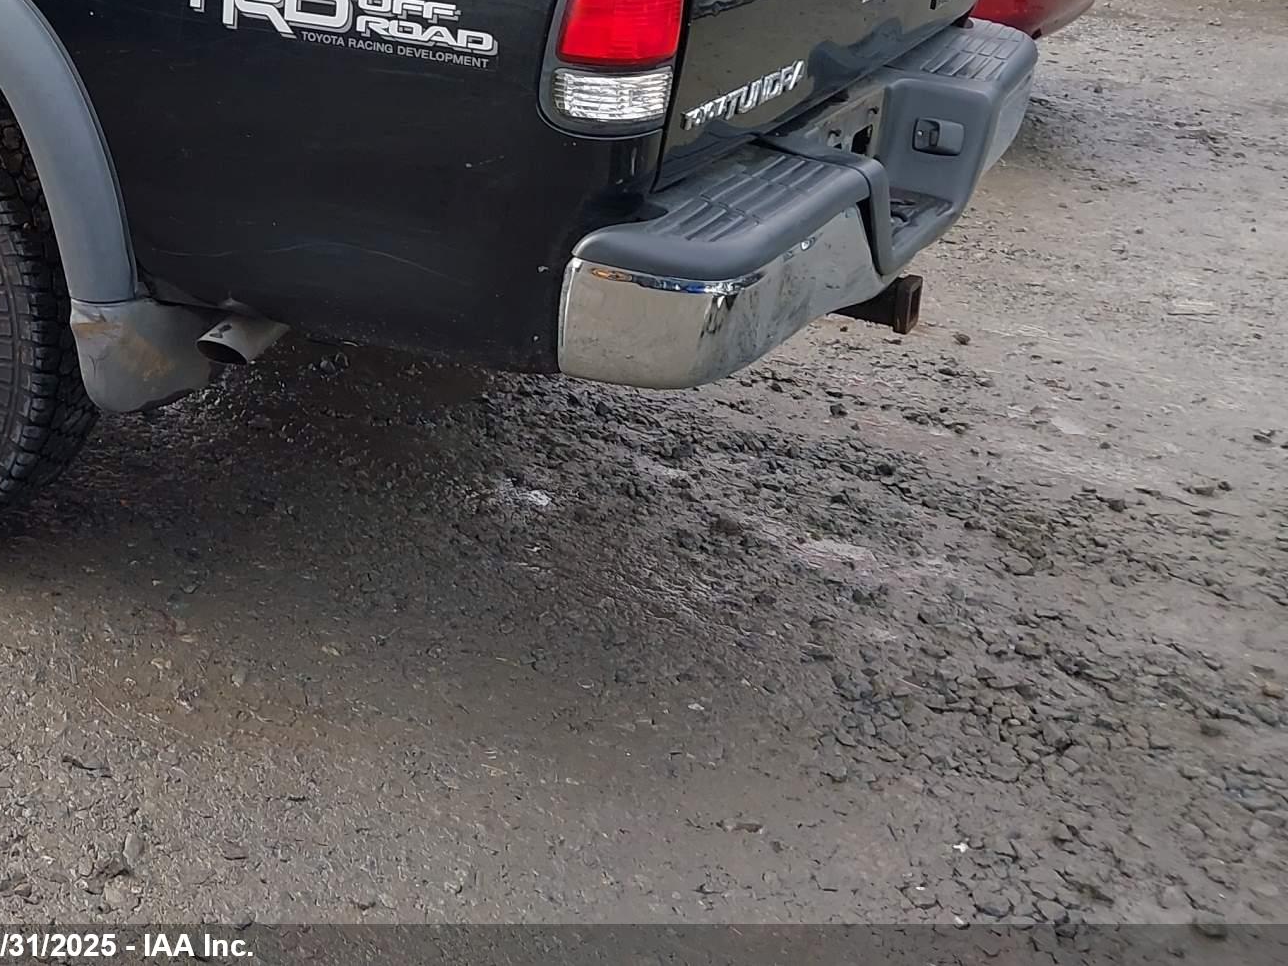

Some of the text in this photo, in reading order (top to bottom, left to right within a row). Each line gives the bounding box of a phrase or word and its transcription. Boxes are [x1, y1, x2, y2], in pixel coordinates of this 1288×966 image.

[300, 30, 489, 69] TOYOTA RACING DEVELOPMENT
[355, 15, 498, 56] ROAD
[725, 59, 806, 121] TUNDRA
